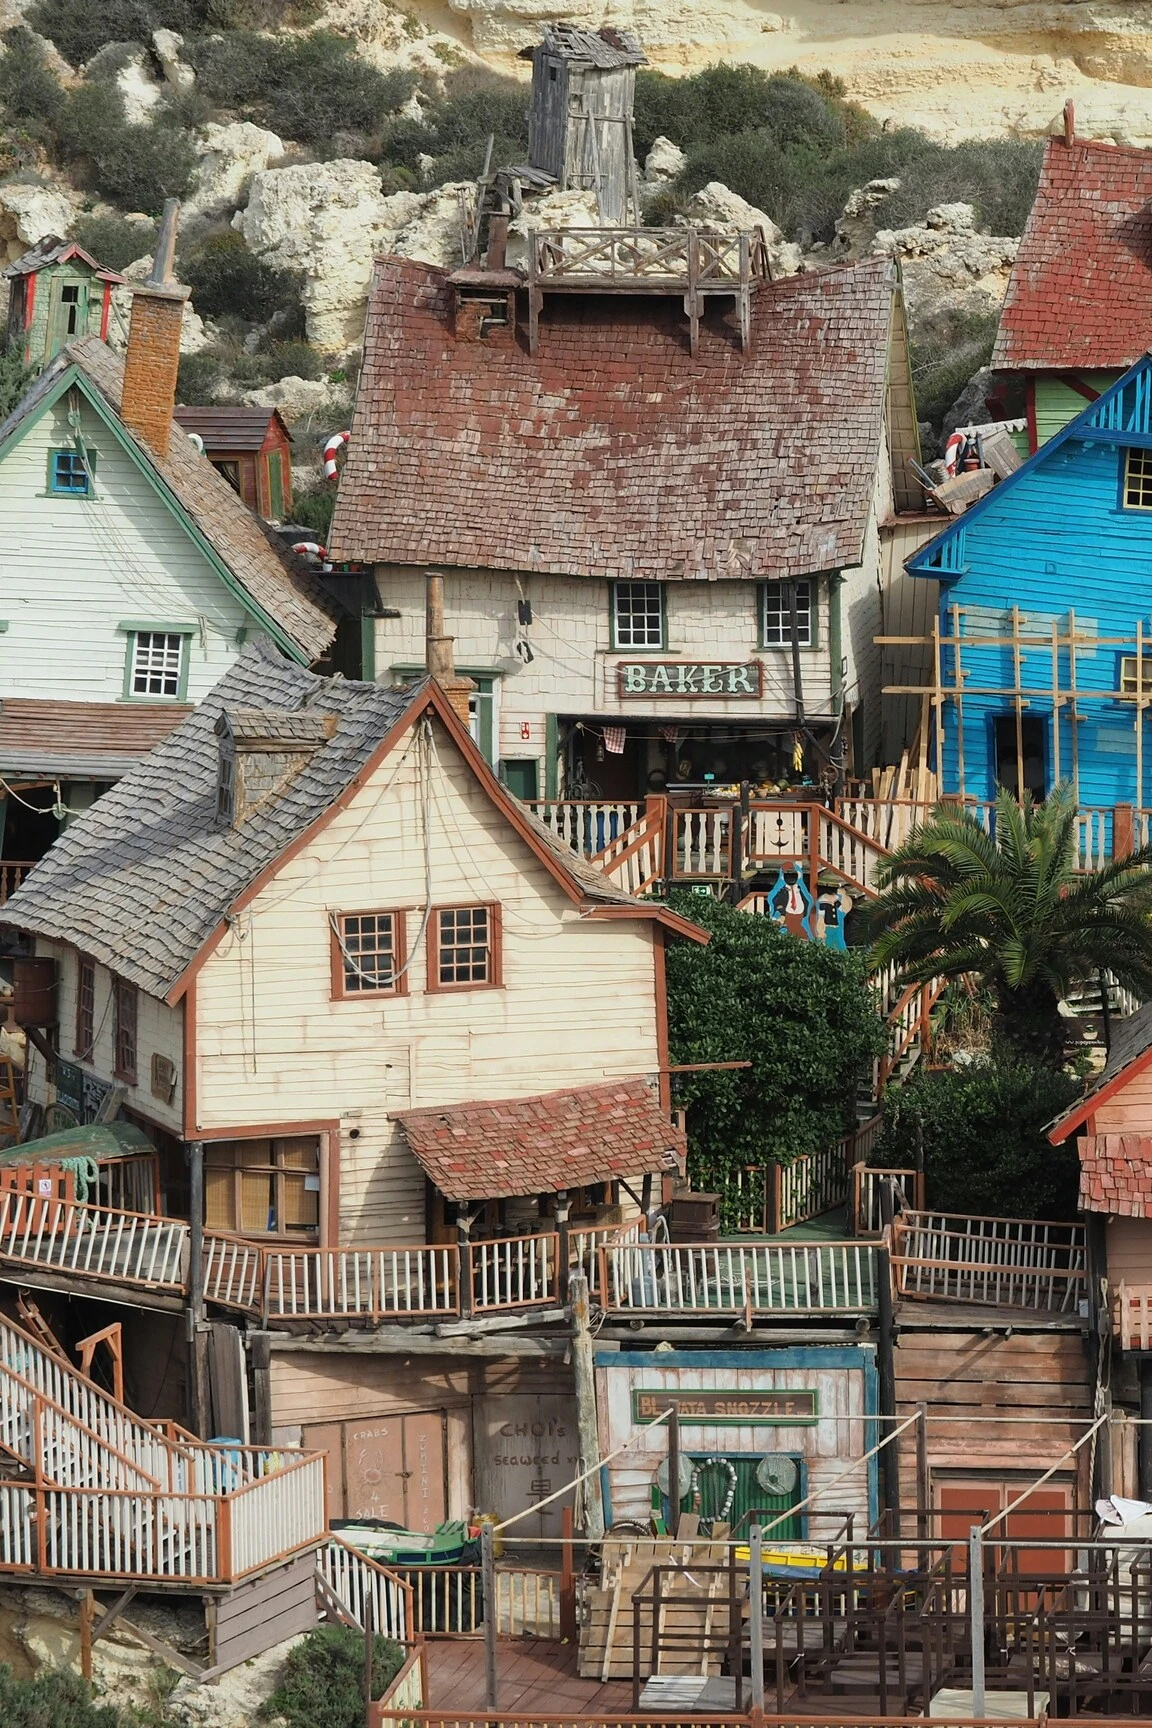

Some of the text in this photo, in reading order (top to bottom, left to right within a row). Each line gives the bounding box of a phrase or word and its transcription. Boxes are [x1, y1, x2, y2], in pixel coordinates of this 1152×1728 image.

[625, 665, 755, 692] BAKER
[353, 1428, 388, 1440] CRABS
[370, 1491, 380, 1502] 4
[355, 1505, 389, 1520] SALE
